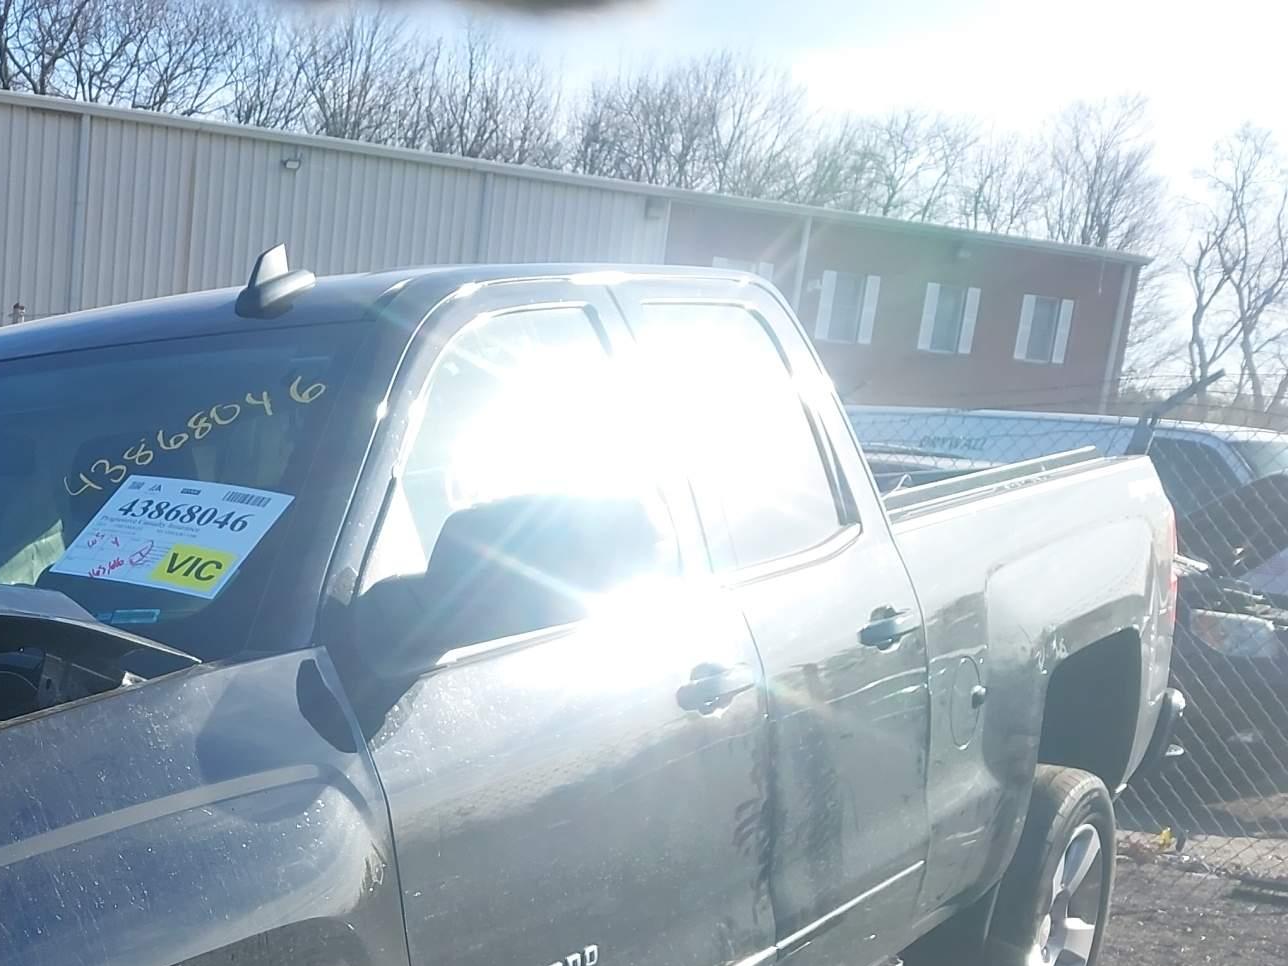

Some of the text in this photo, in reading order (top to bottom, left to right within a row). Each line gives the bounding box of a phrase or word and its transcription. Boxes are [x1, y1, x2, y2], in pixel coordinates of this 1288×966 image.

[64, 376, 326, 496] 43868046
[118, 499, 255, 533] 43868046
[166, 552, 223, 581] VIC
